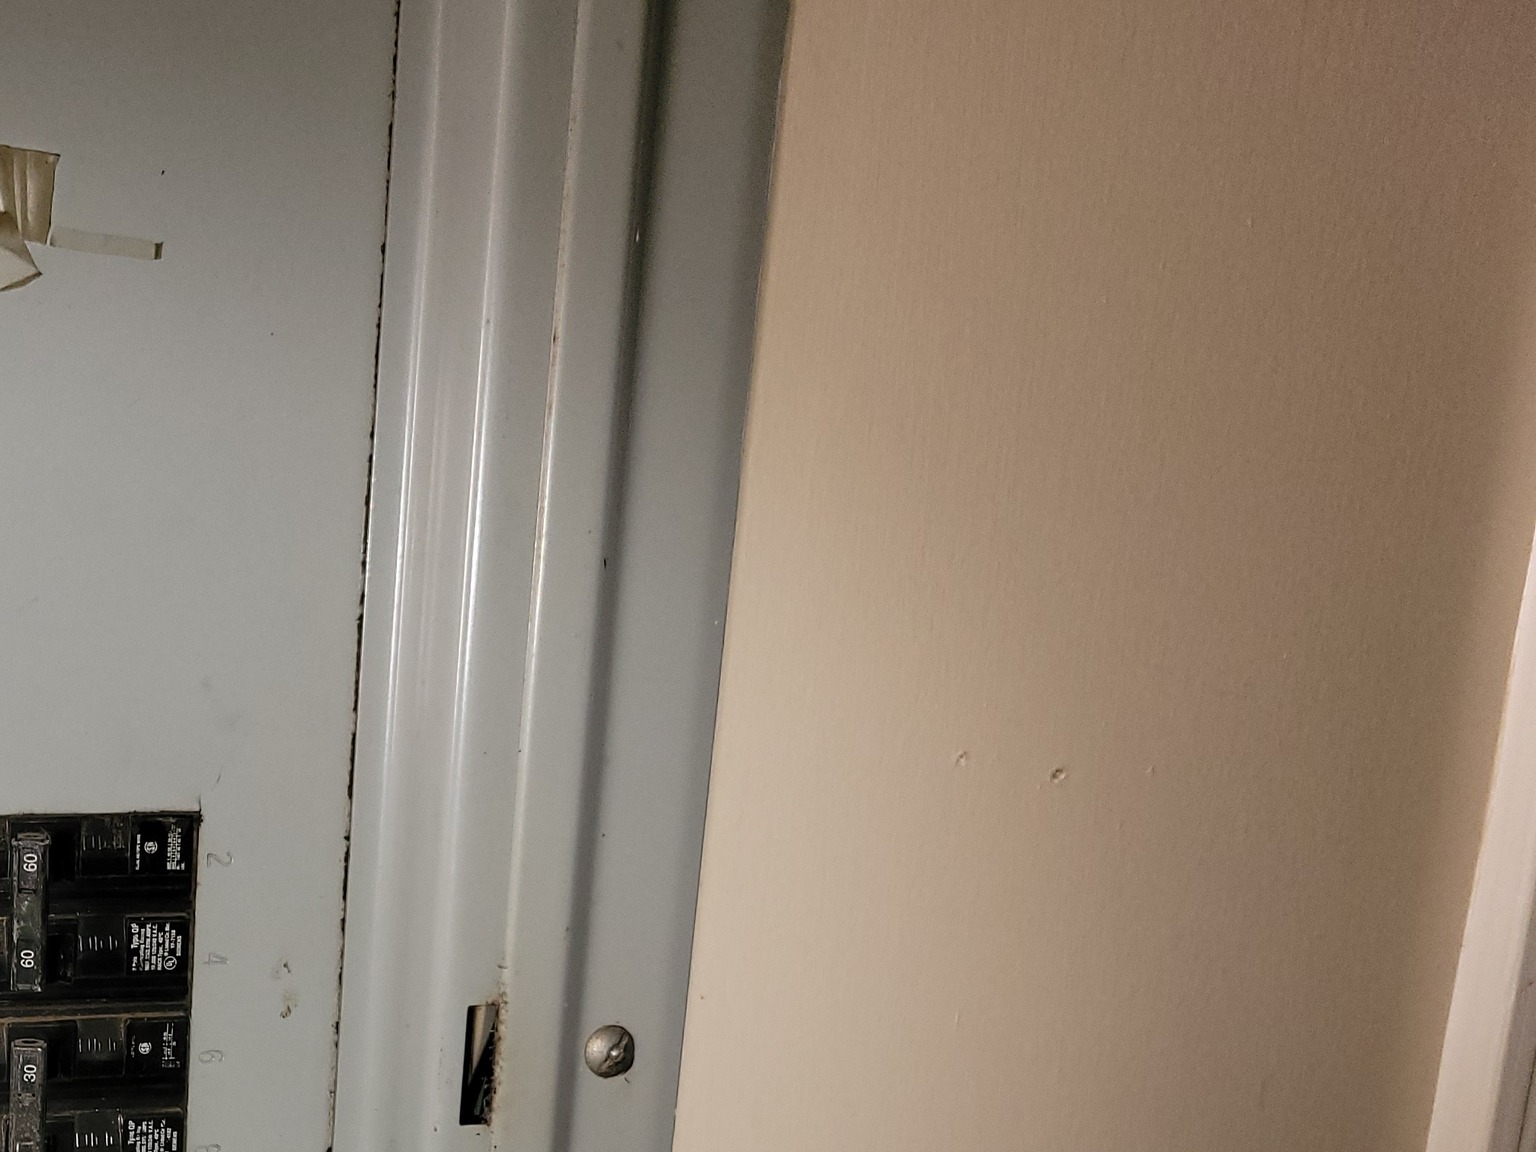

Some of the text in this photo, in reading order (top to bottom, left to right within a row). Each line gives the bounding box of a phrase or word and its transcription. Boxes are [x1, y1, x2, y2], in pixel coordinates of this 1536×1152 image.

[23, 853, 37, 872] 60
[207, 851, 234, 868] 2
[20, 950, 34, 968] 60
[204, 951, 230, 967] 4
[198, 1049, 225, 1064] 6
[23, 1064, 36, 1083] 30
